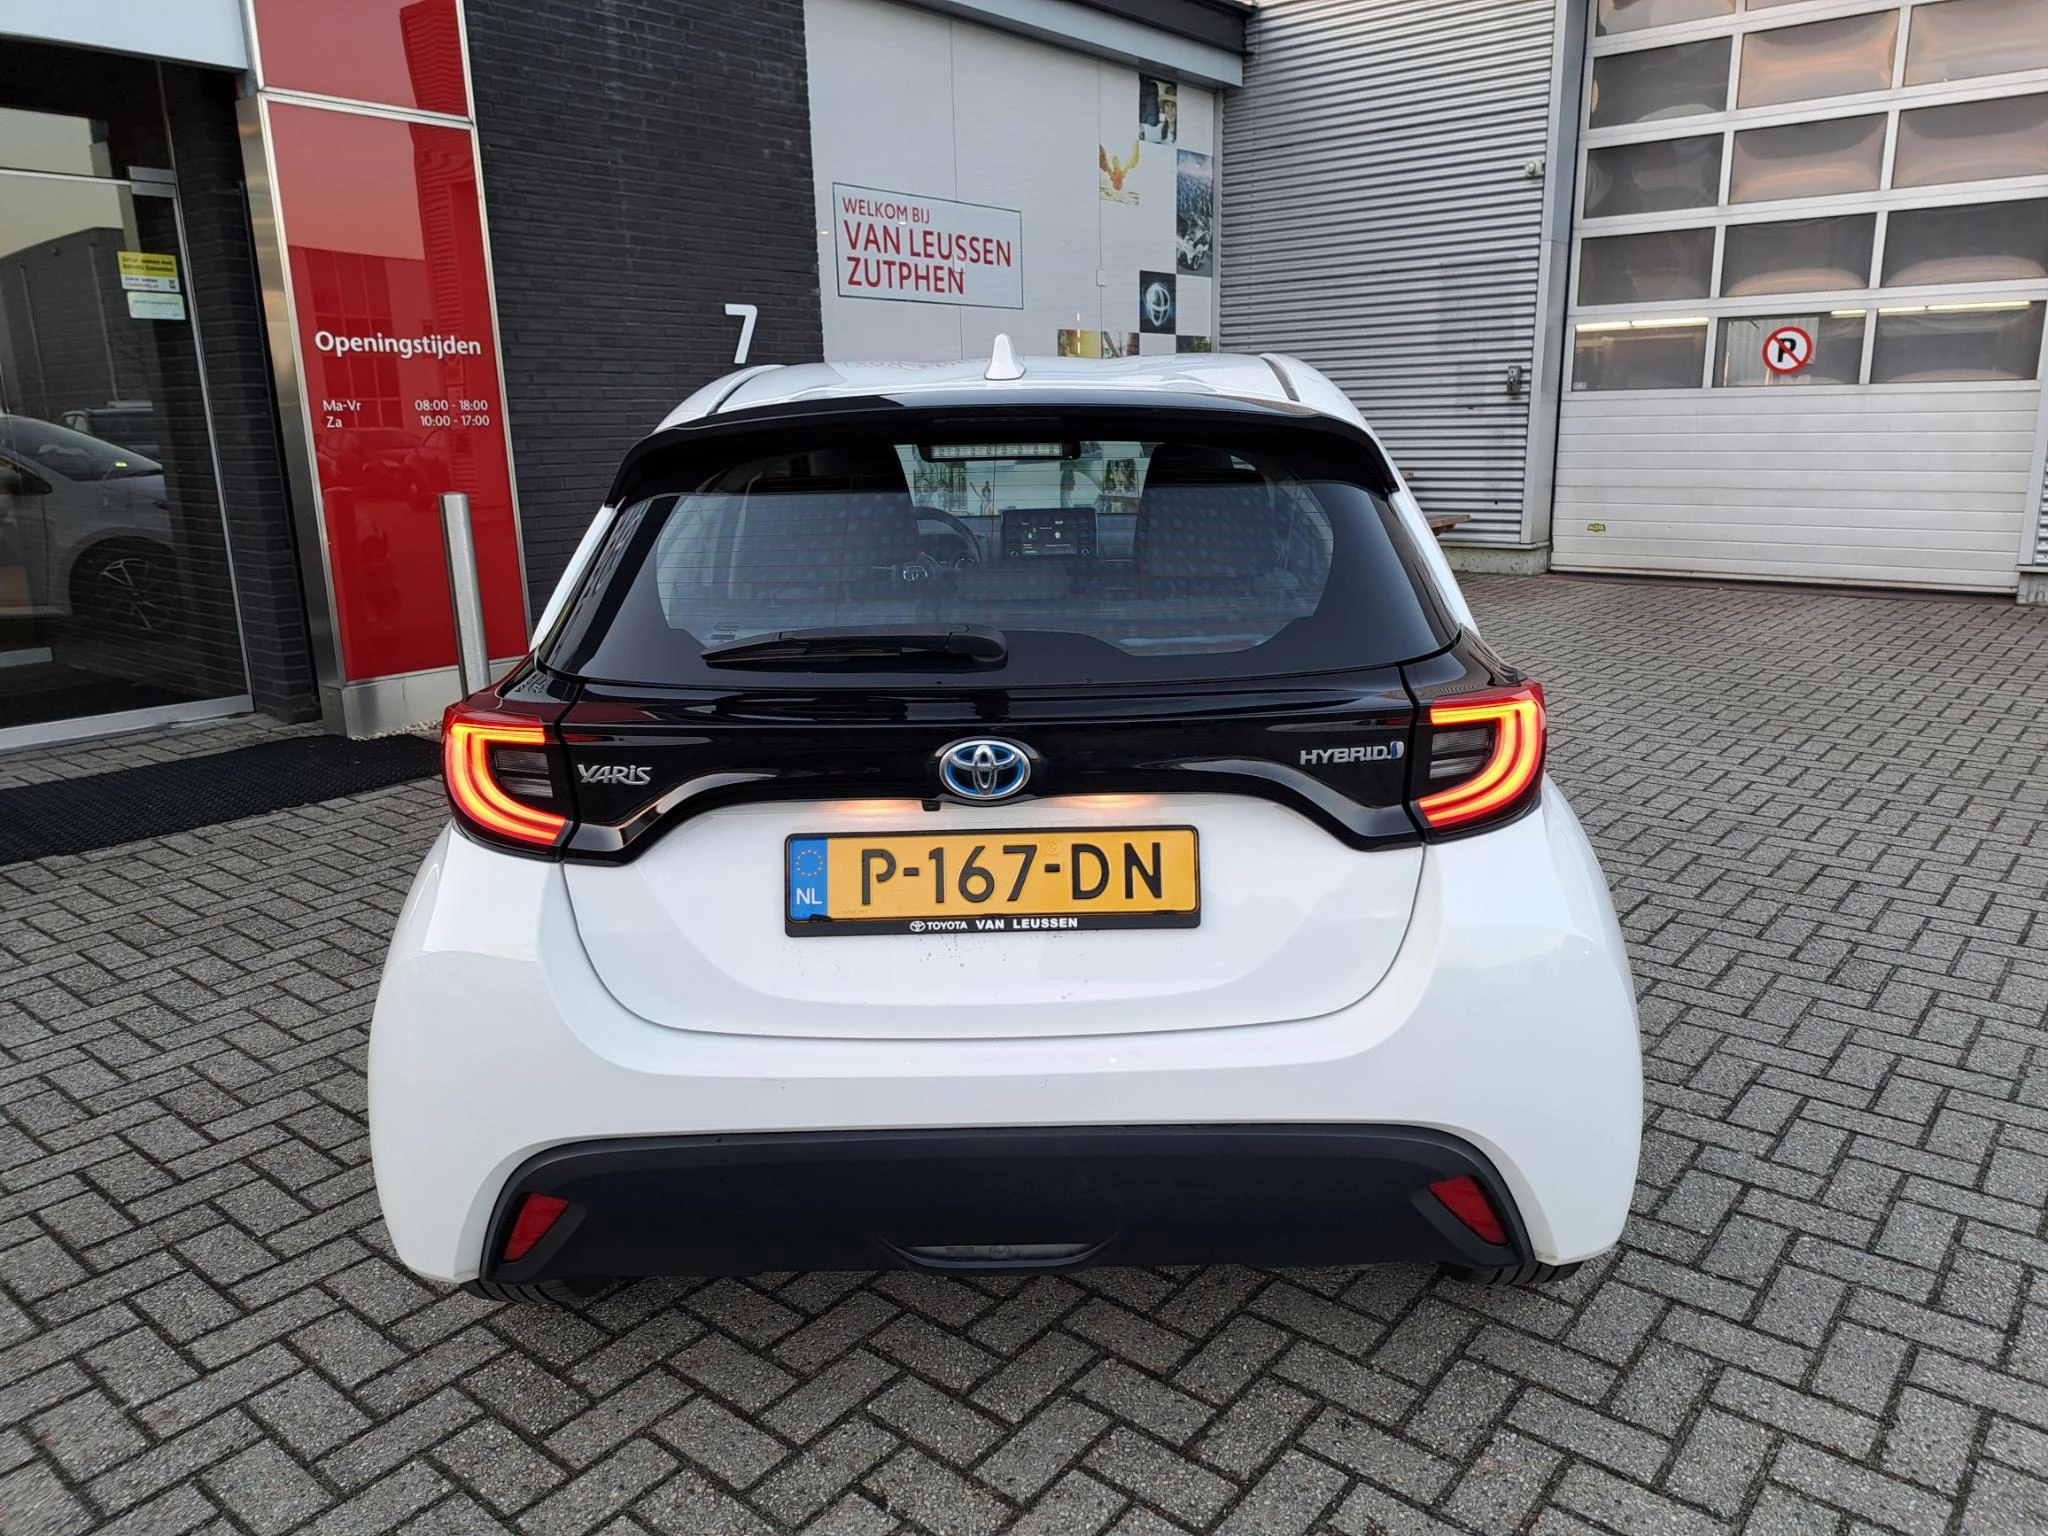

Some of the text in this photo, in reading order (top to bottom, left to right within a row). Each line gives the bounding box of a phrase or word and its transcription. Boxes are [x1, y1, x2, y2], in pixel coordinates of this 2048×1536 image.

[842, 196, 930, 224] WELKOM BIJ
[843, 219, 1012, 268] VAN LEUSSEN
[846, 256, 964, 295] ZUTPHEN
[724, 303, 758, 364] 7
[314, 330, 482, 360] Openingstijden
[322, 400, 362, 412] Ma-Vr
[414, 400, 449, 411] 08:00
[459, 400, 488, 411] 18:00
[326, 416, 343, 428] Za
[420, 415, 451, 427] 10:00
[462, 415, 490, 426] 17:00
[1299, 745, 1389, 765] HYBRID
[861, 842, 1163, 906] P-167-DN
[796, 887, 823, 905] NL
[926, 917, 1078, 931] TOYOTA VAN LEUSSEN
